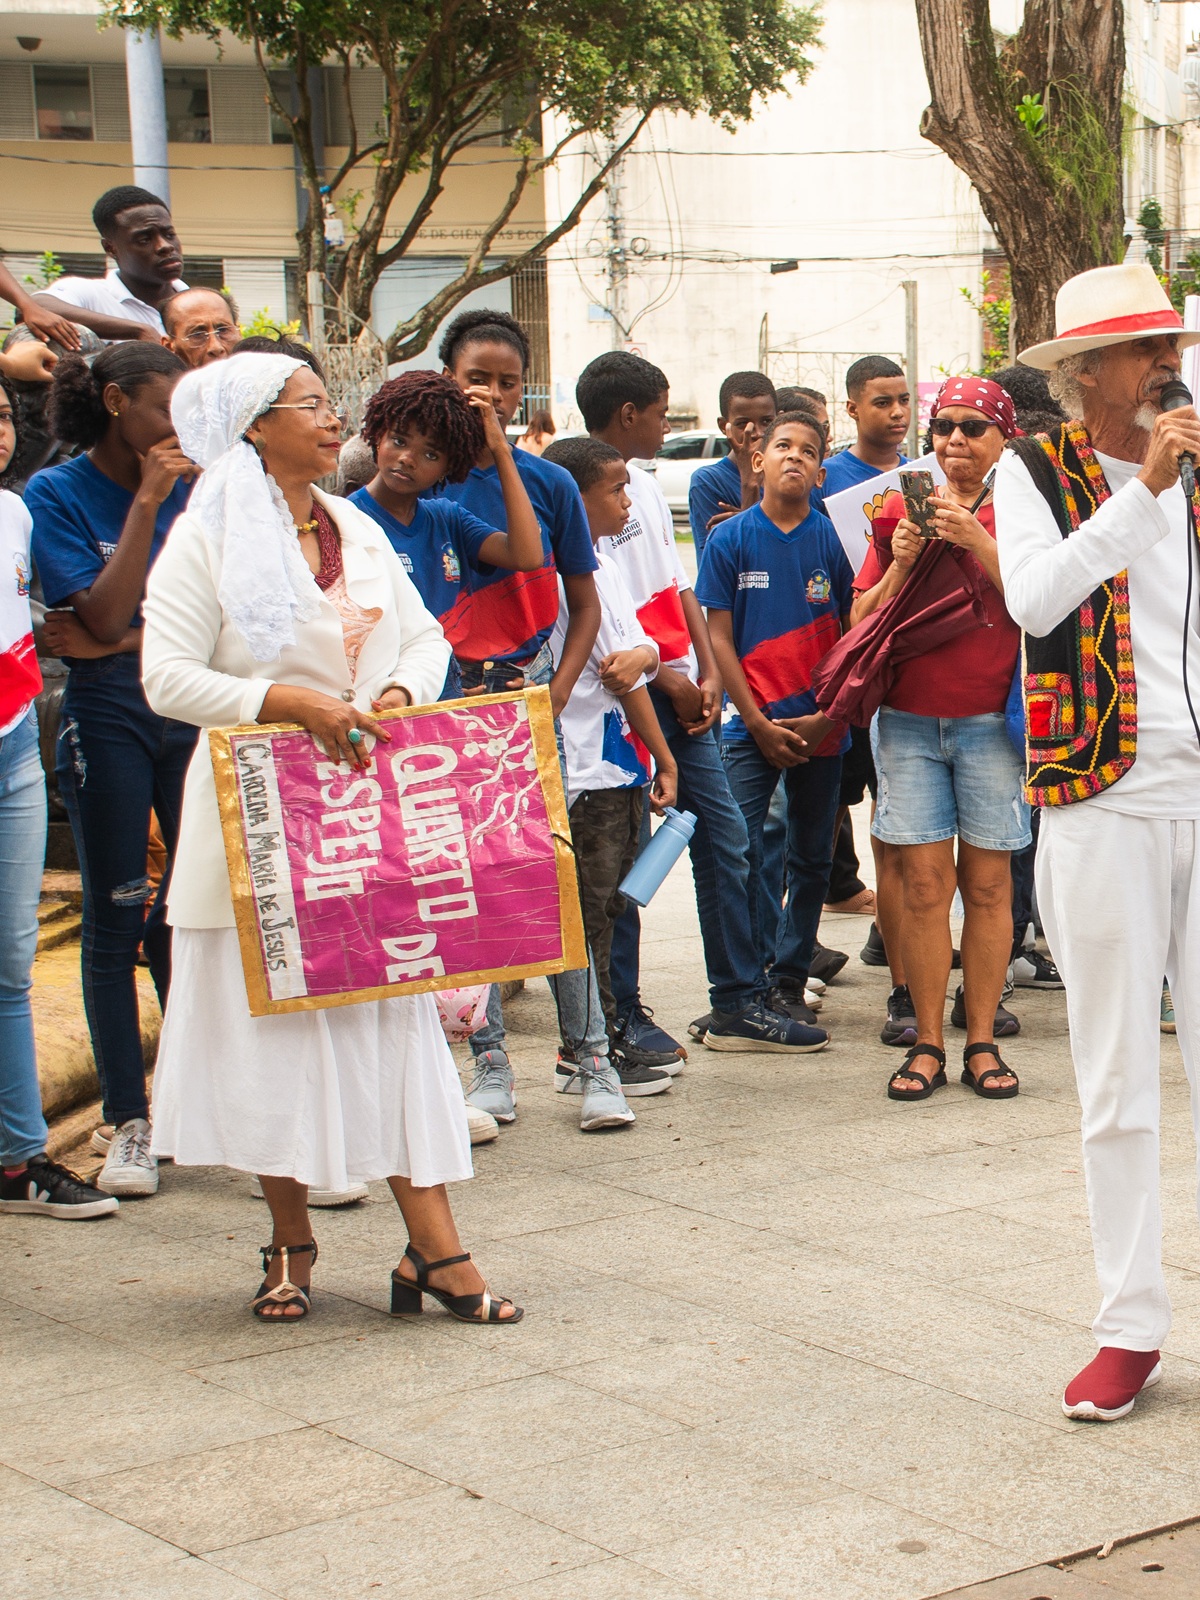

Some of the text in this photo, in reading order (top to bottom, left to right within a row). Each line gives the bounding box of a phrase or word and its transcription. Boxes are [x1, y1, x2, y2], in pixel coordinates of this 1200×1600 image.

[381, 744, 479, 983] QUARTO DE
[261, 917, 295, 972] JESUS
